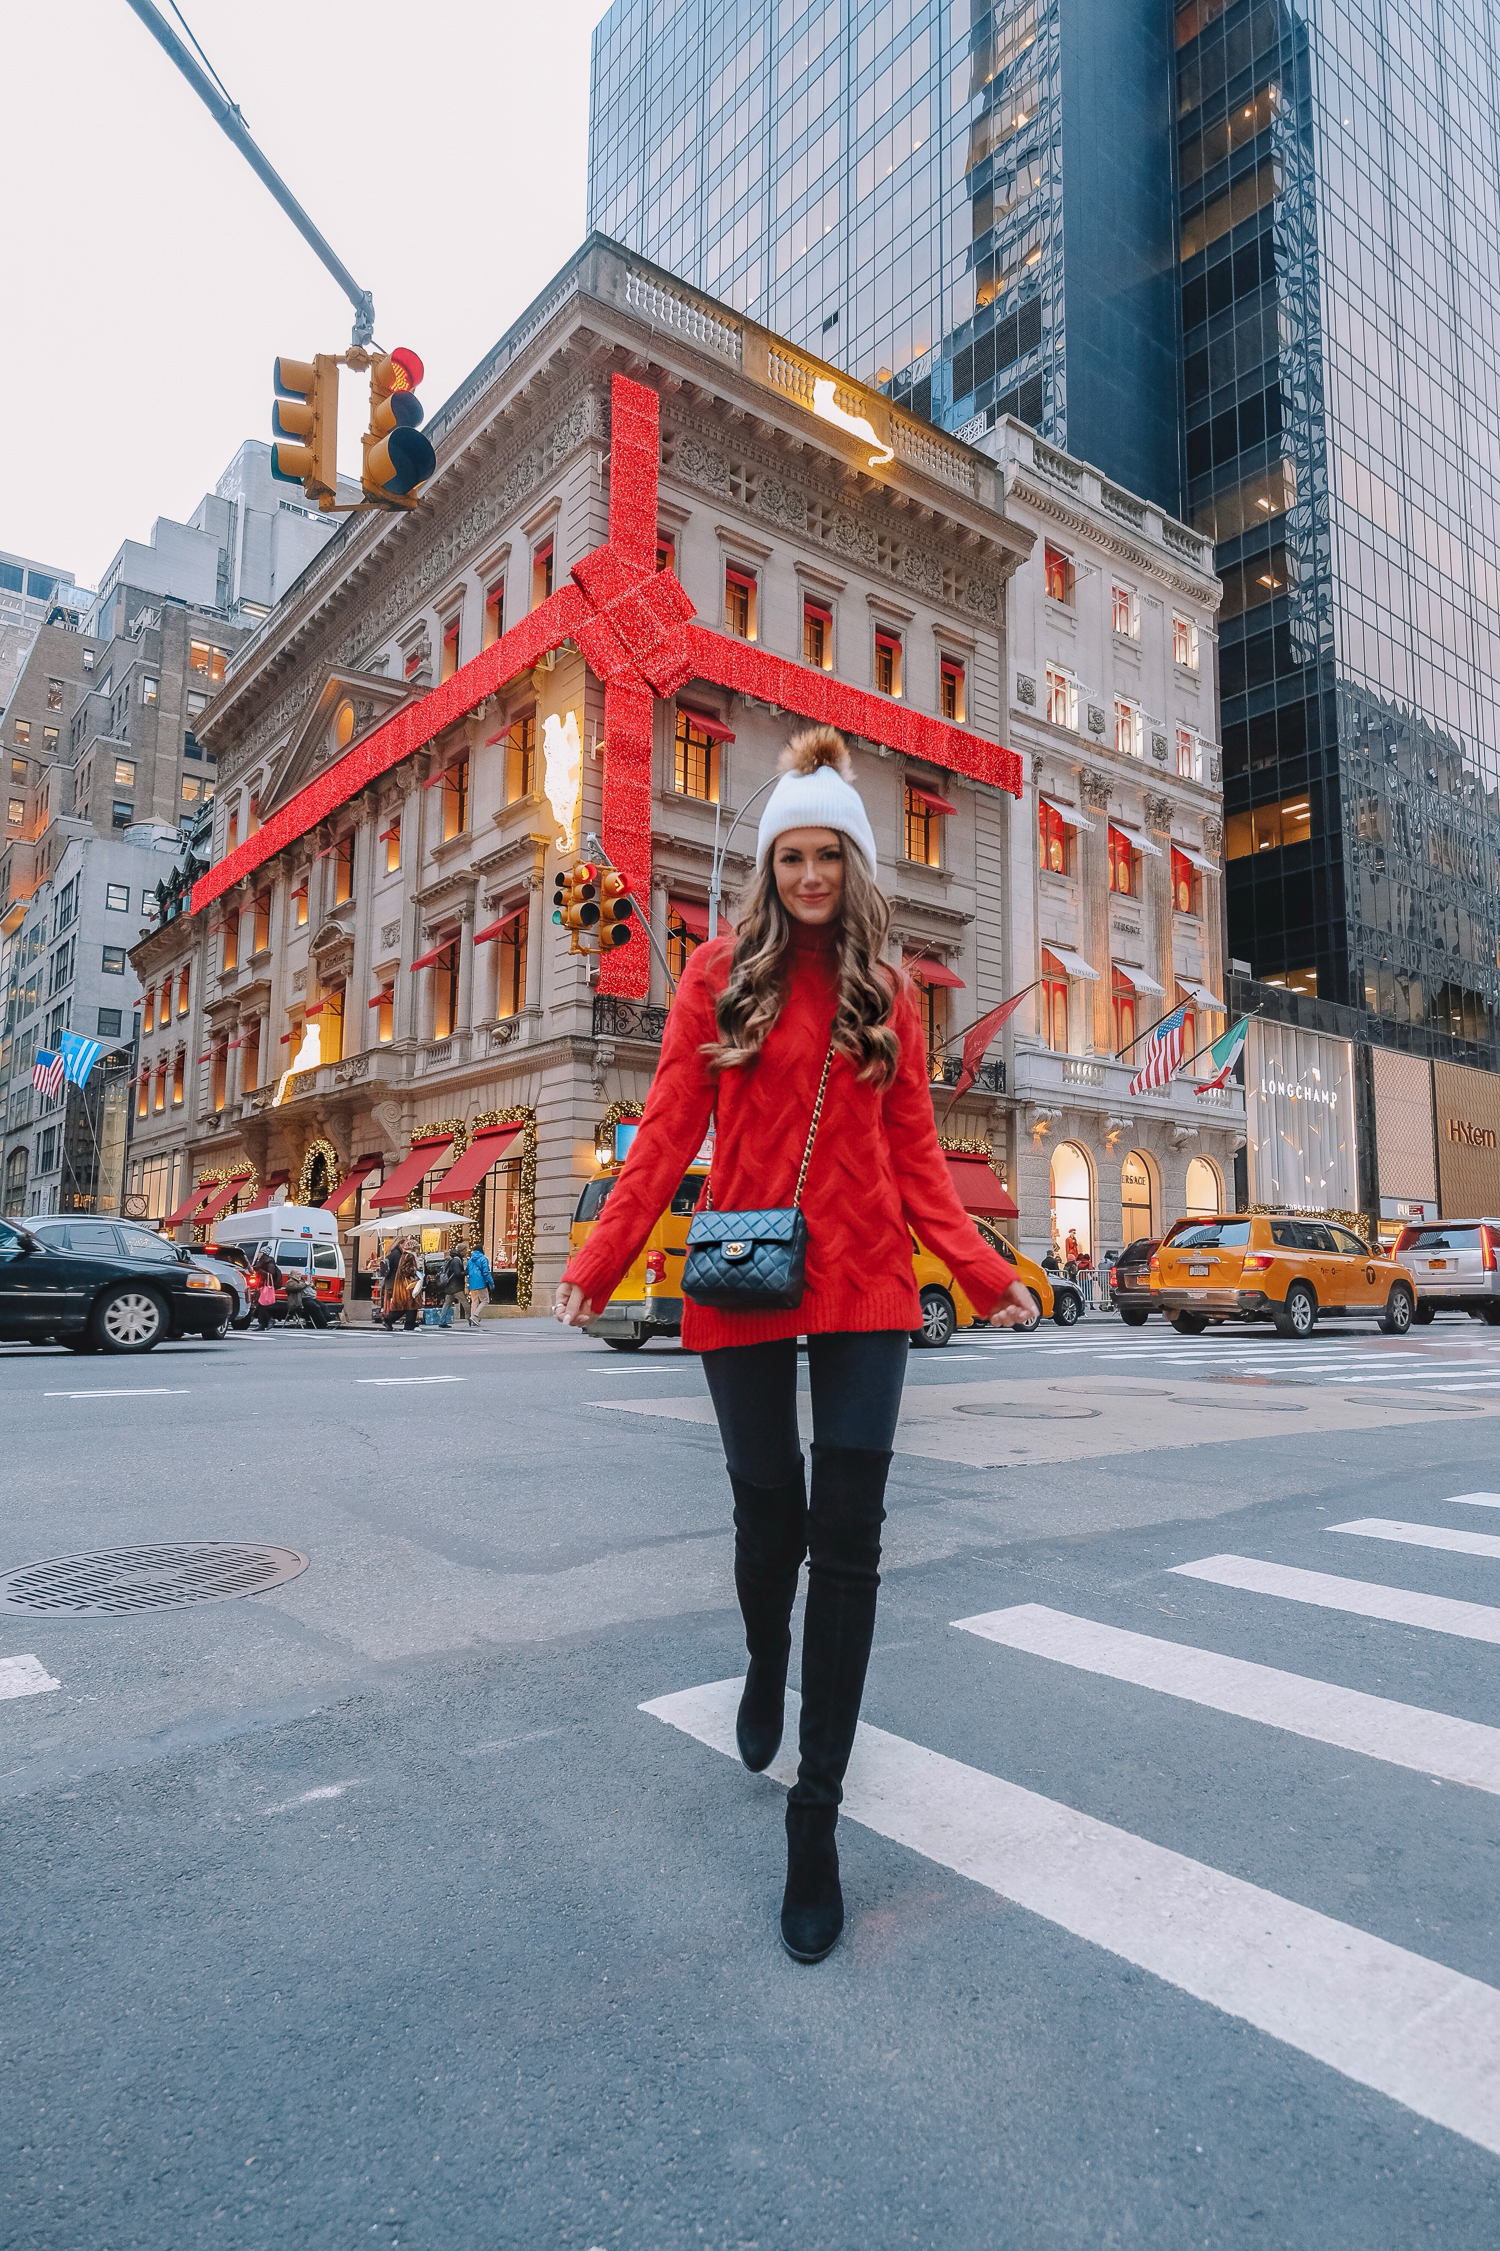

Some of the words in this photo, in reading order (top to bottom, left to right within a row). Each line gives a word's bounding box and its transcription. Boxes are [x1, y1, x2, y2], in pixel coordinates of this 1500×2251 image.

[1113, 921, 1141, 935] VERSACE
[325, 953, 345, 968] Cartier
[1261, 1078, 1338, 1105] LONGCHAMP
[1121, 1174, 1146, 1186] ERSACE
